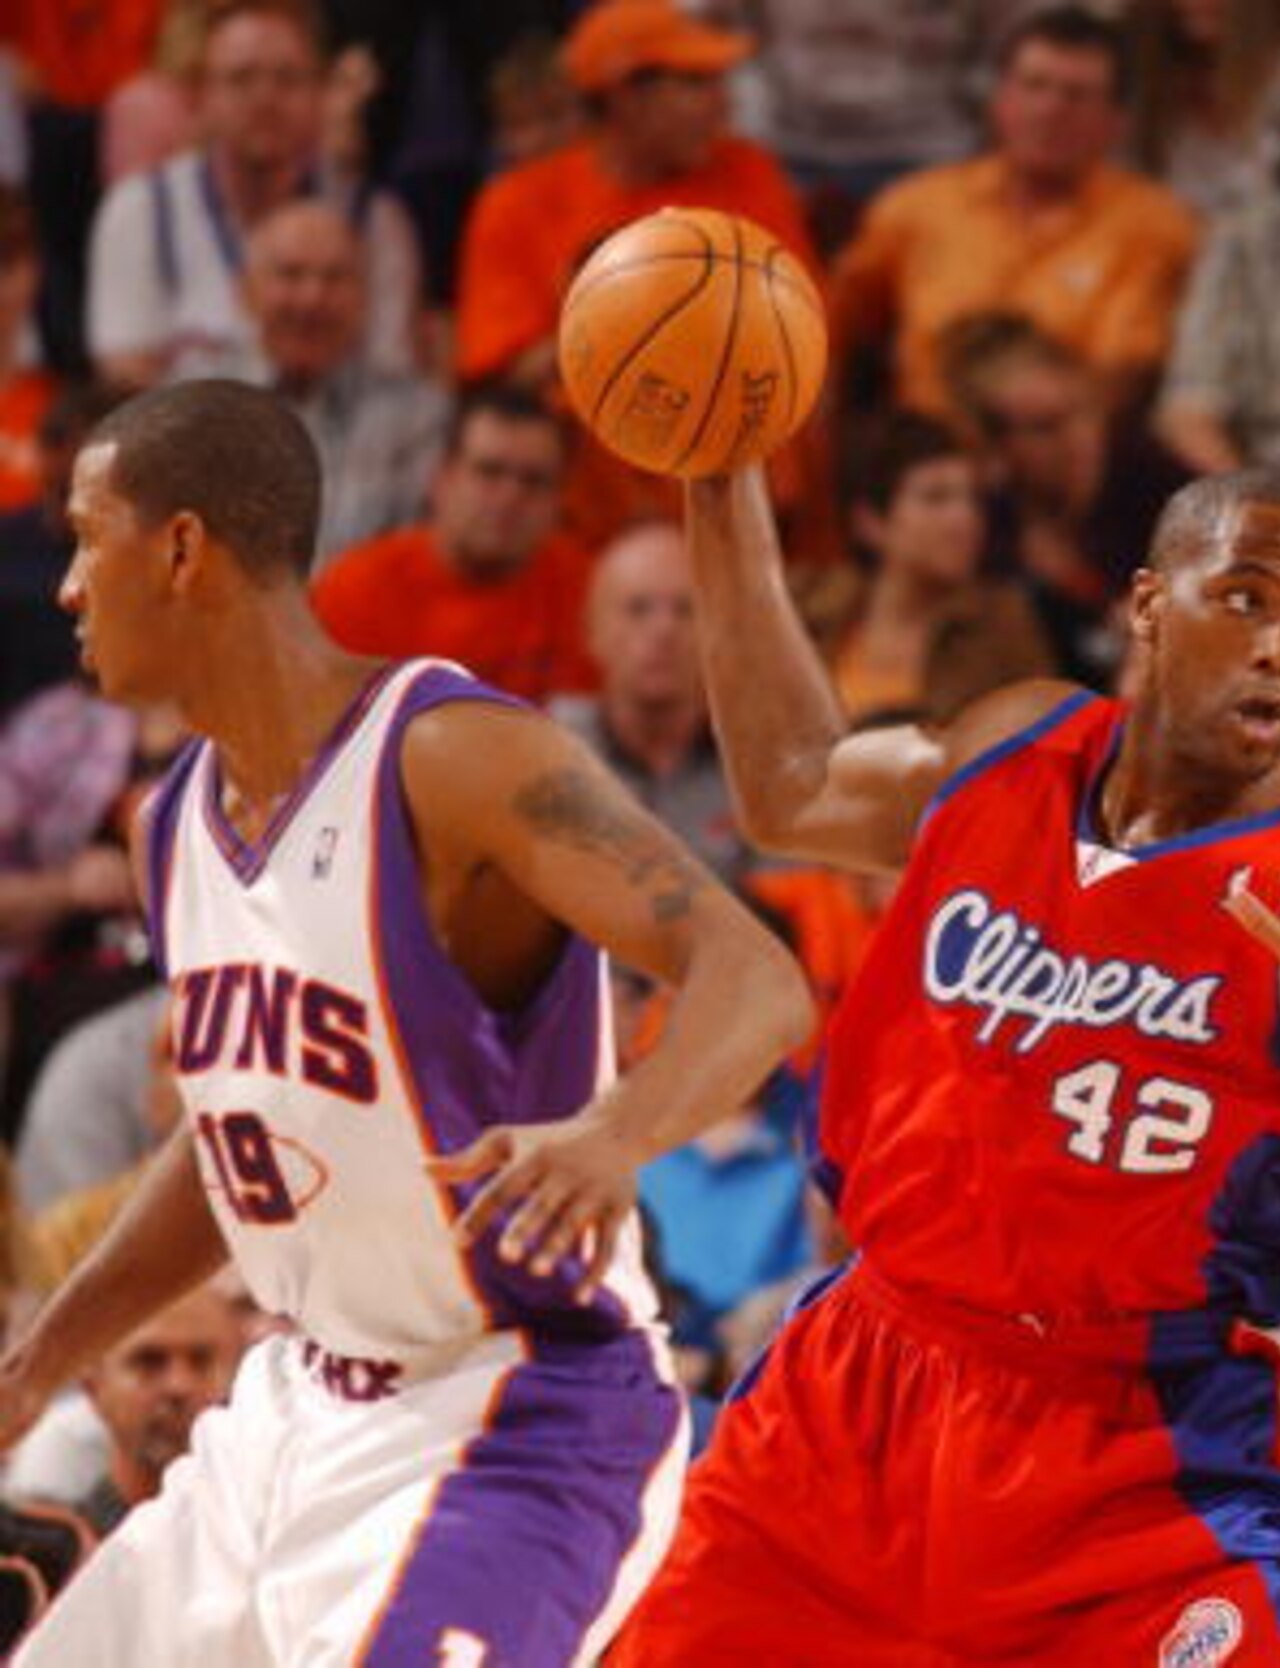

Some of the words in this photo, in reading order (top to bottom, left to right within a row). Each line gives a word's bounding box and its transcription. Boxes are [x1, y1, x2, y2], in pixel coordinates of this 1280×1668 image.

[172, 960, 379, 1104] UNS
[922, 888, 1222, 1054] Clippers
[199, 1111, 298, 1224] 19
[1052, 1058, 1214, 1174] 42
